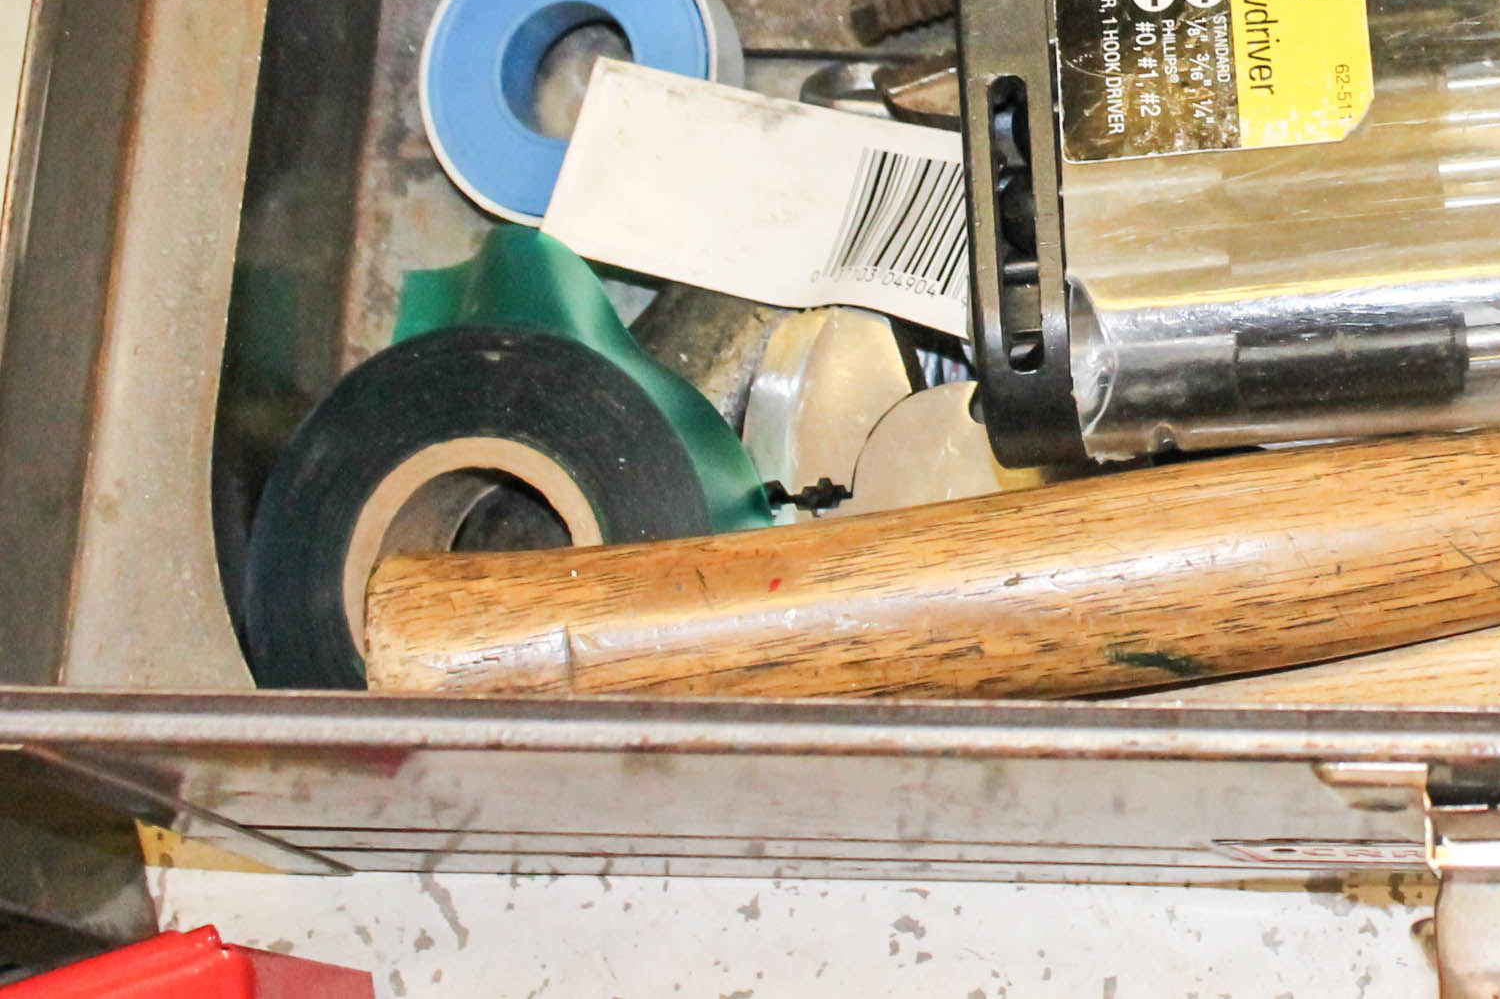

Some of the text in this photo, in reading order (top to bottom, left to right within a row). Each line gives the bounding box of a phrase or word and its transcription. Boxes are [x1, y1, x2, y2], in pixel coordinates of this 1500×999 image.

[1102, 29, 1121, 74] HOOK
[1212, 14, 1231, 83] STANDARD
[1105, 76, 1126, 135] DRIVER
[1139, 92, 1162, 118] #2
[881, 271, 936, 298] 04904
